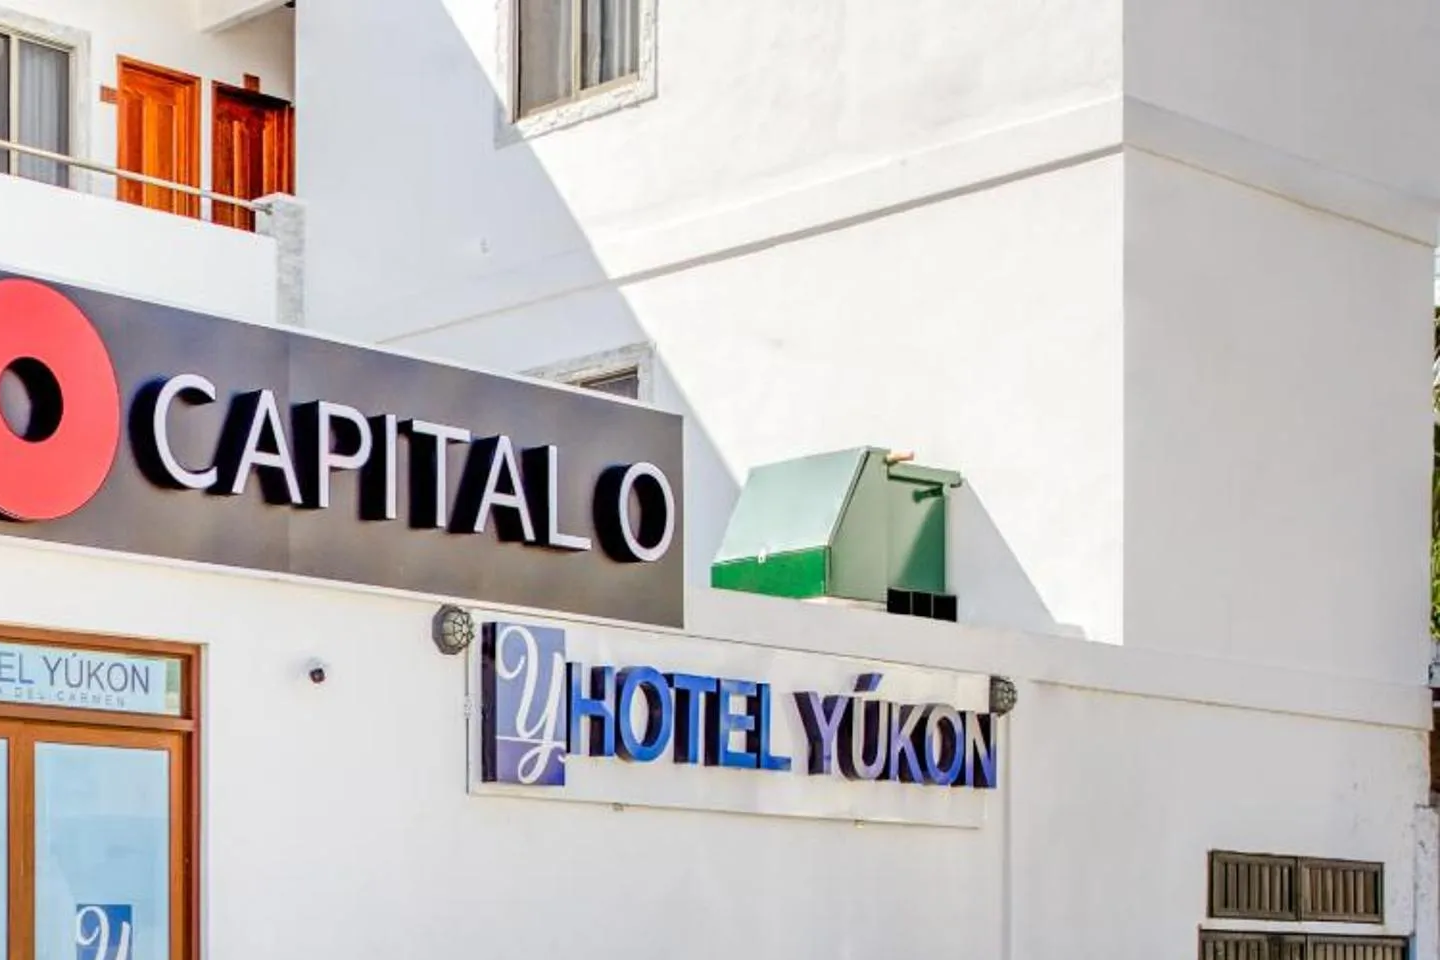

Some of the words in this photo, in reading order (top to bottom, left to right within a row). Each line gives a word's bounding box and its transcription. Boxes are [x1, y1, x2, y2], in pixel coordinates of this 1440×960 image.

[136, 371, 592, 551] CAPITAL
[604, 459, 676, 563] O
[42, 652, 151, 695] YÚKON
[565, 660, 791, 772] HOTEL
[793, 672, 998, 789] YÚKON
